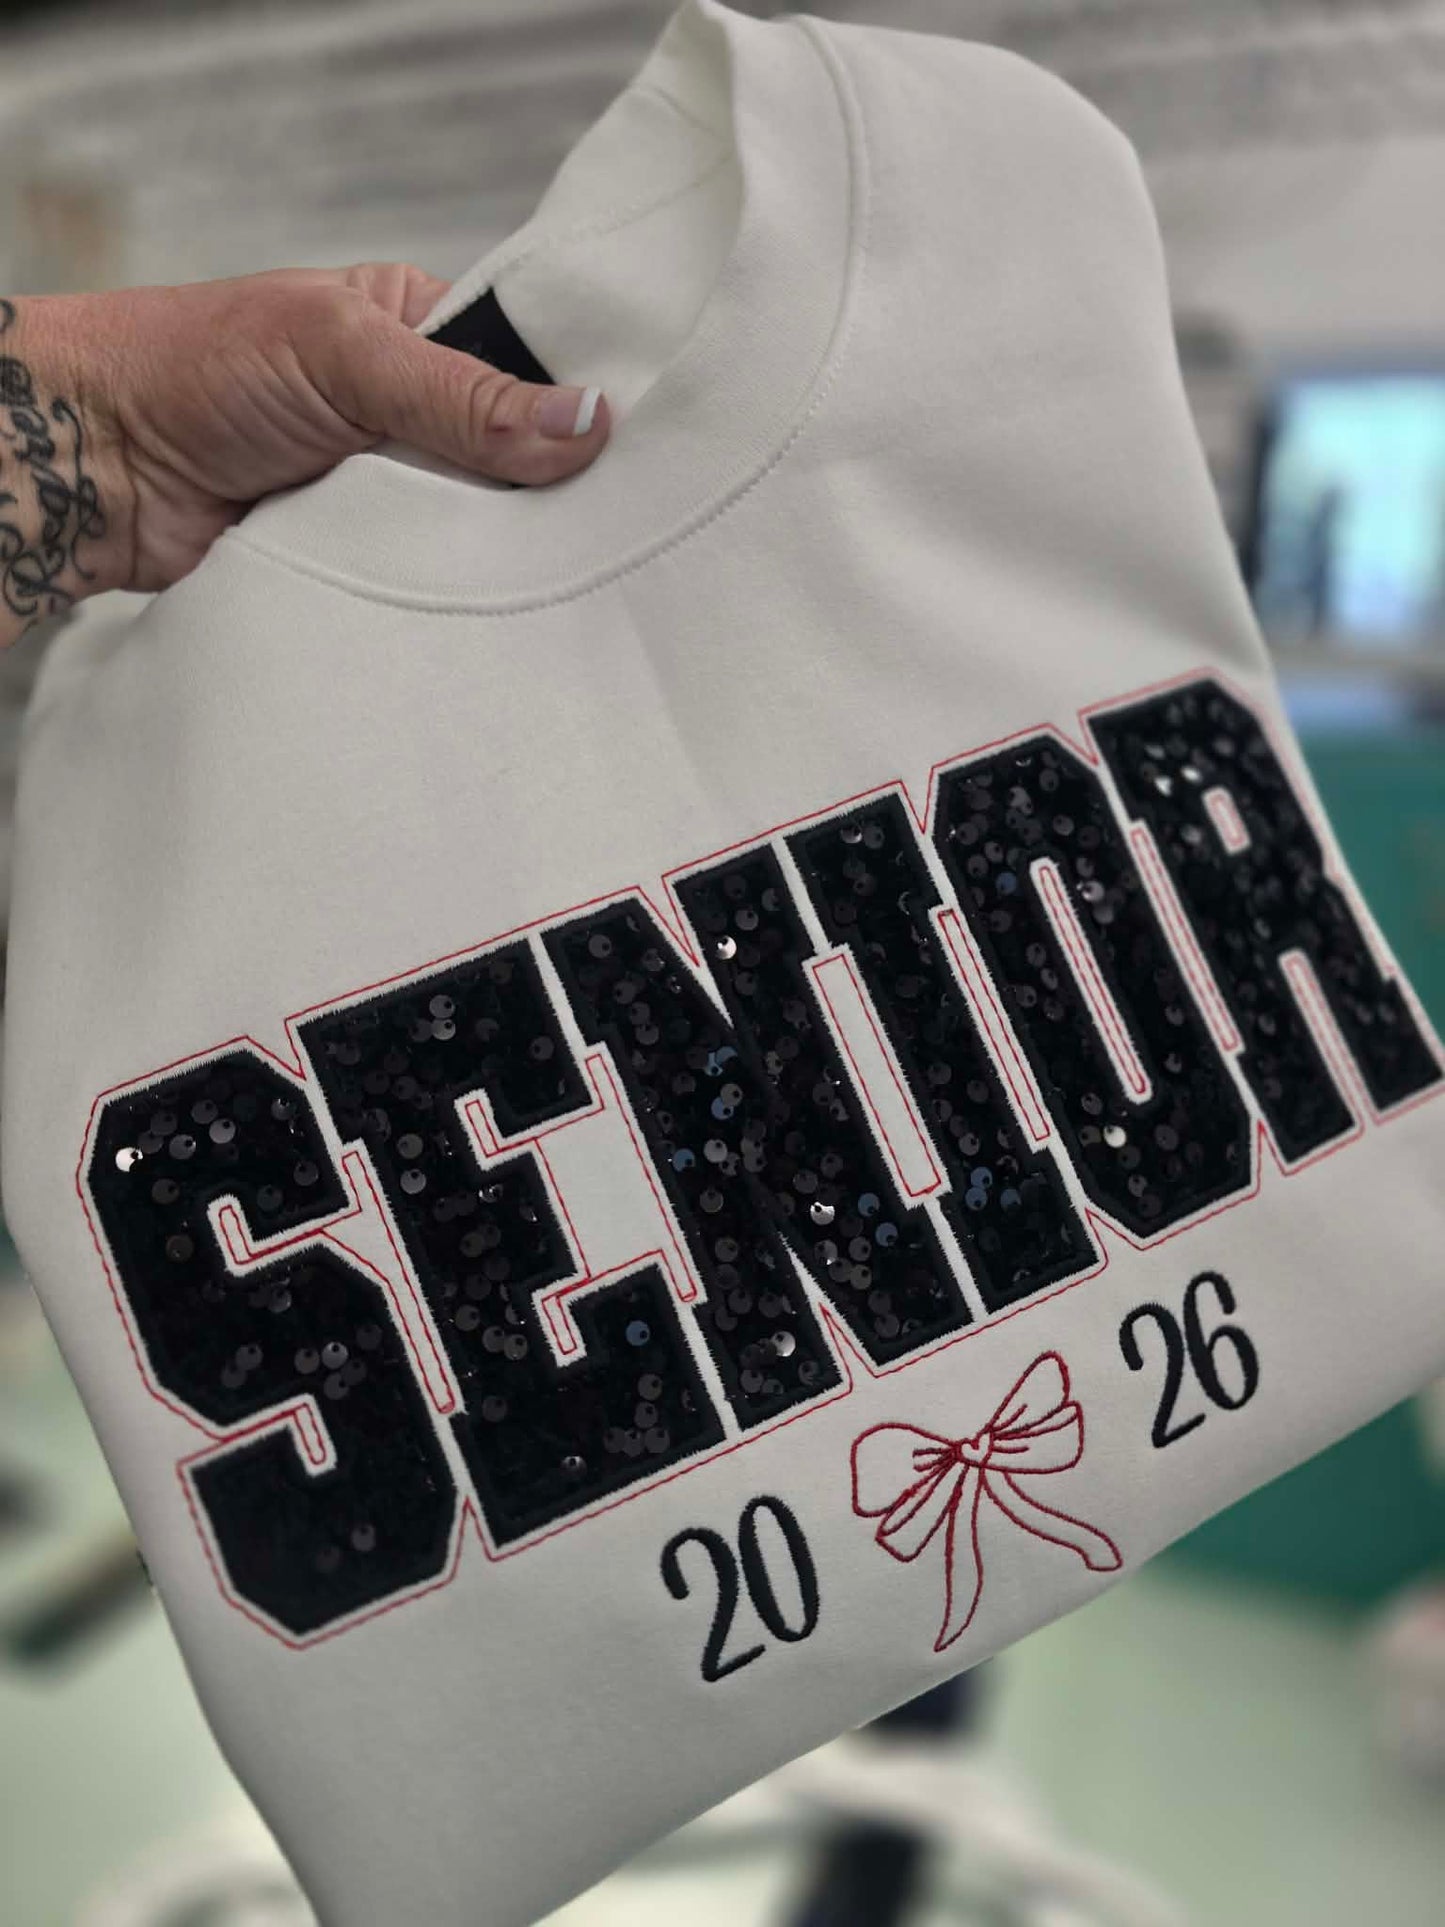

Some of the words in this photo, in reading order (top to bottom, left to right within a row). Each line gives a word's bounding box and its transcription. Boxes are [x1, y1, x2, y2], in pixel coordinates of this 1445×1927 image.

[84, 678, 1445, 1638] SENIOR
[659, 1495, 820, 1682] 20
[1118, 1271, 1260, 1449] 26
